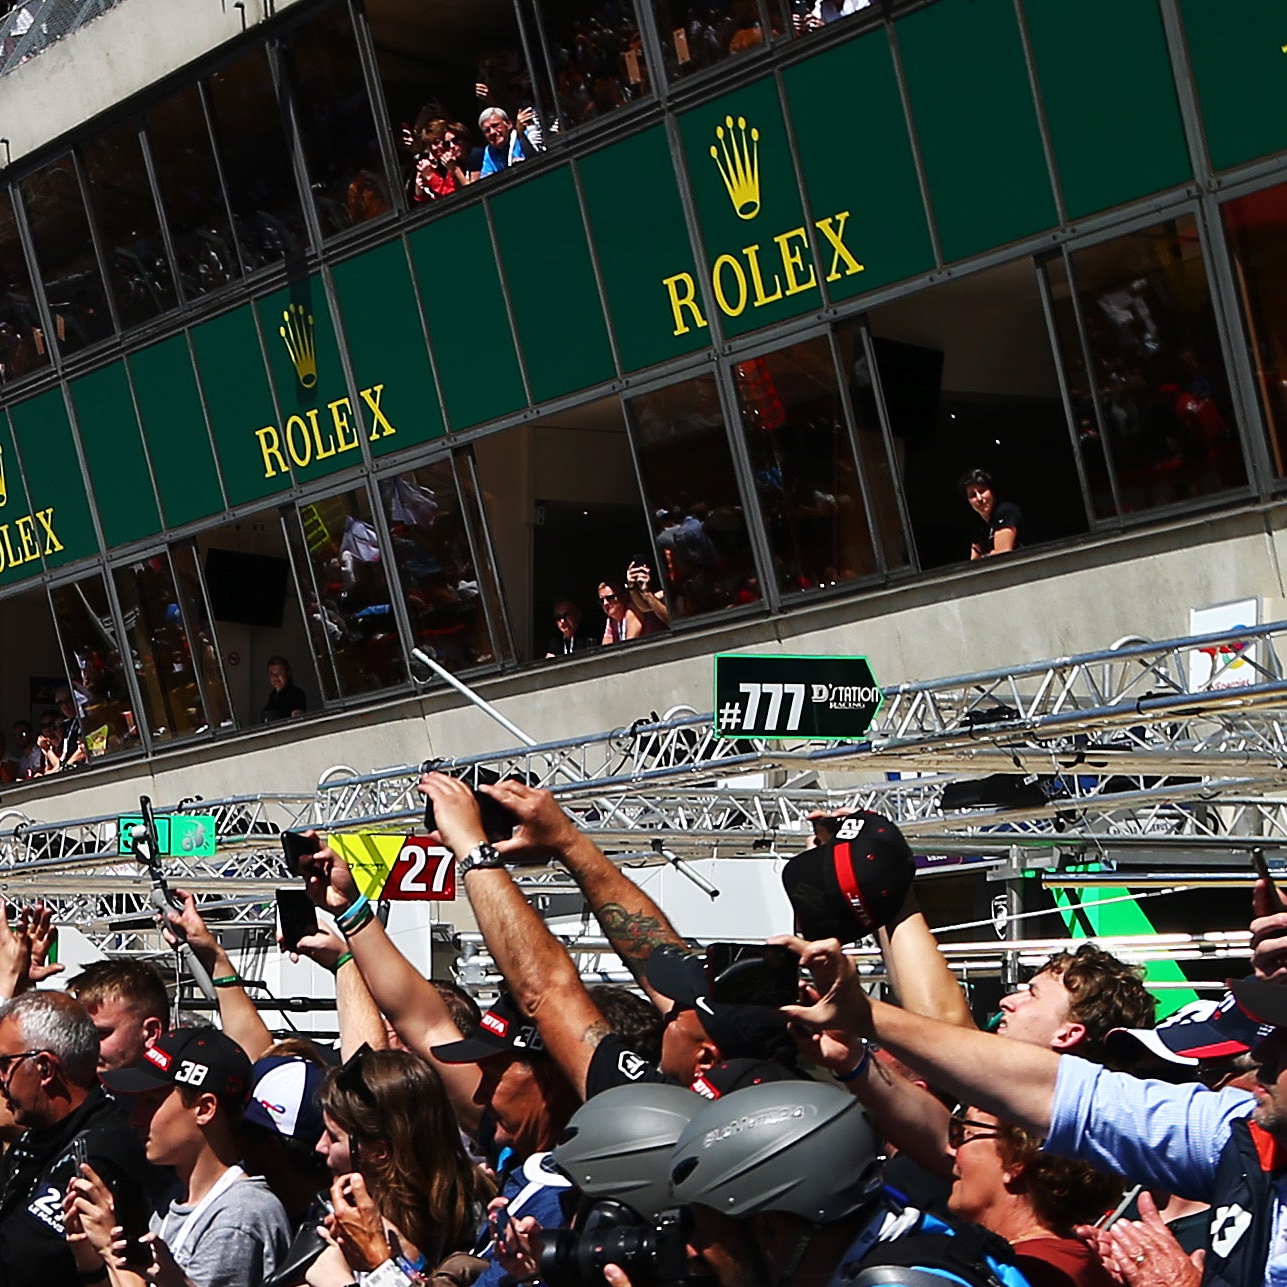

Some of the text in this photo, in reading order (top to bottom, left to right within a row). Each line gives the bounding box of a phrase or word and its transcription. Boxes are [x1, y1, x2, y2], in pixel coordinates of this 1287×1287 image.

[662, 211, 864, 337] ROLEX
[255, 384, 395, 478] ROLEX
[719, 683, 805, 731] #777
[399, 845, 455, 892] 27
[175, 1059, 209, 1086] 38
